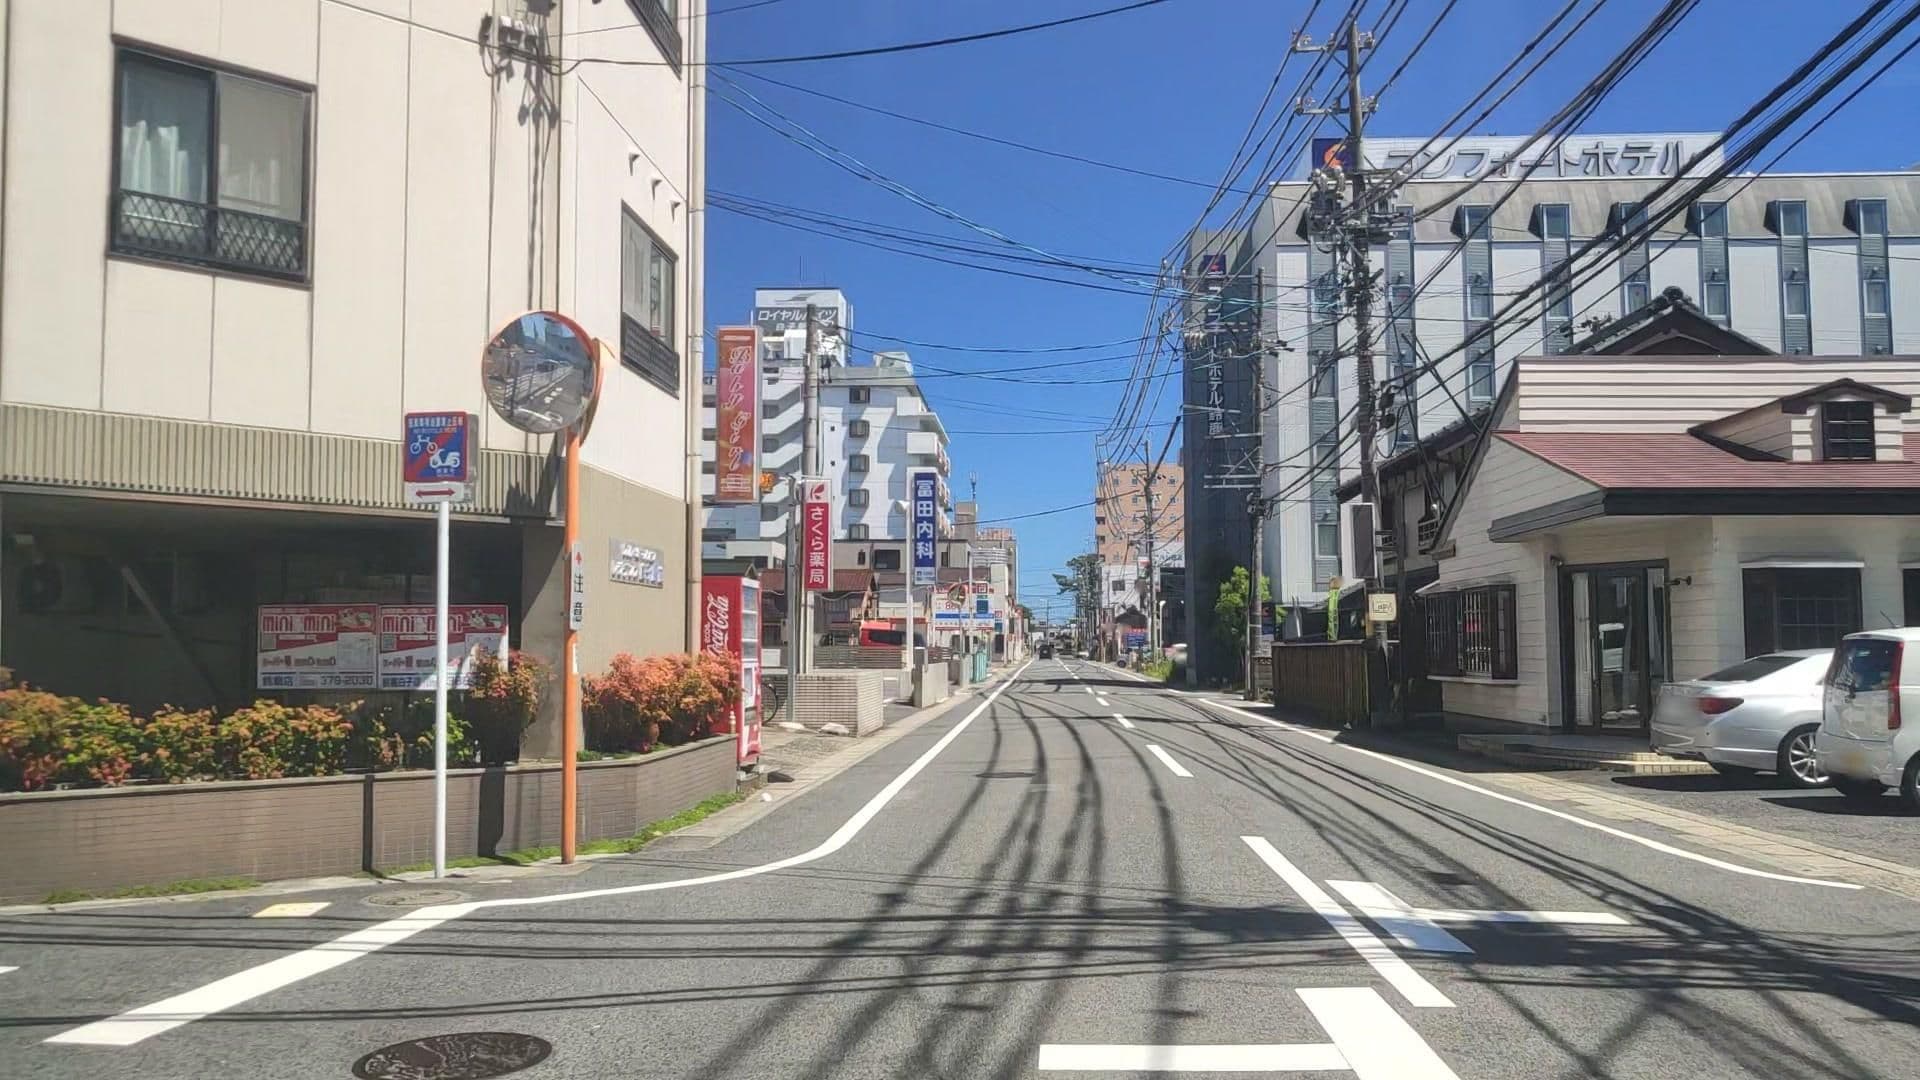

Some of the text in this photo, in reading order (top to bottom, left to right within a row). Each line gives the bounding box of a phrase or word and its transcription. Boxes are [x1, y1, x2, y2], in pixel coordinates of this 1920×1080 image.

[1388, 141, 1684, 178] コンフォートホテル
[808, 505, 826, 584] さくら薬局
[915, 479, 935, 559] 富田内科
